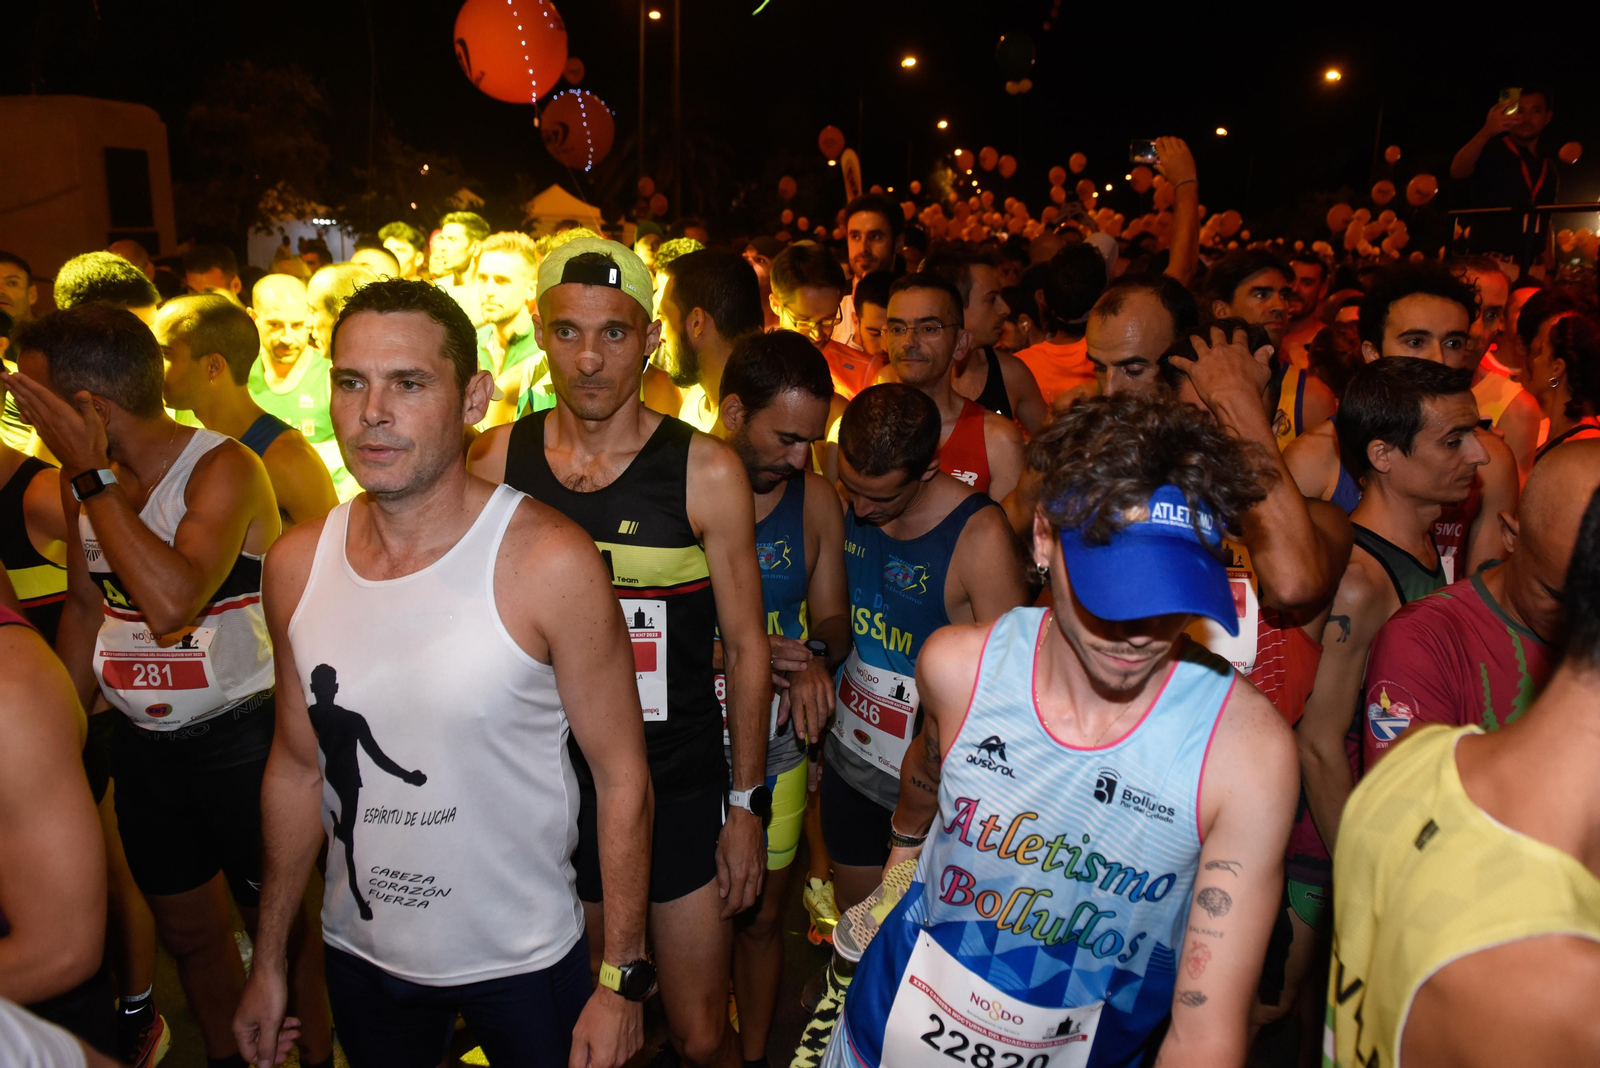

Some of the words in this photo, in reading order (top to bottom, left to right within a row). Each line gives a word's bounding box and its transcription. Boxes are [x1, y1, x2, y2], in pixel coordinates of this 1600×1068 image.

[1151, 502, 1213, 530] ATLETMO
[616, 576, 639, 584] Team
[132, 663, 173, 687] 281
[849, 690, 880, 725] 246
[966, 754, 1016, 779] austral
[363, 805, 404, 825] ESPÍRITU
[403, 811, 419, 827] DE
[420, 806, 457, 826] LUCHA
[943, 797, 1177, 903] Atletismo
[370, 866, 435, 885] CABEZA
[368, 878, 452, 898] CORAZÓN
[368, 888, 430, 909] FUERZA
[939, 865, 1148, 964] Bollullos
[912, 977, 931, 994] XXXV
[929, 991, 952, 1014] CARRERA
[951, 1011, 988, 1036] NOCTURNA
[987, 1030, 1000, 1041] DEL
